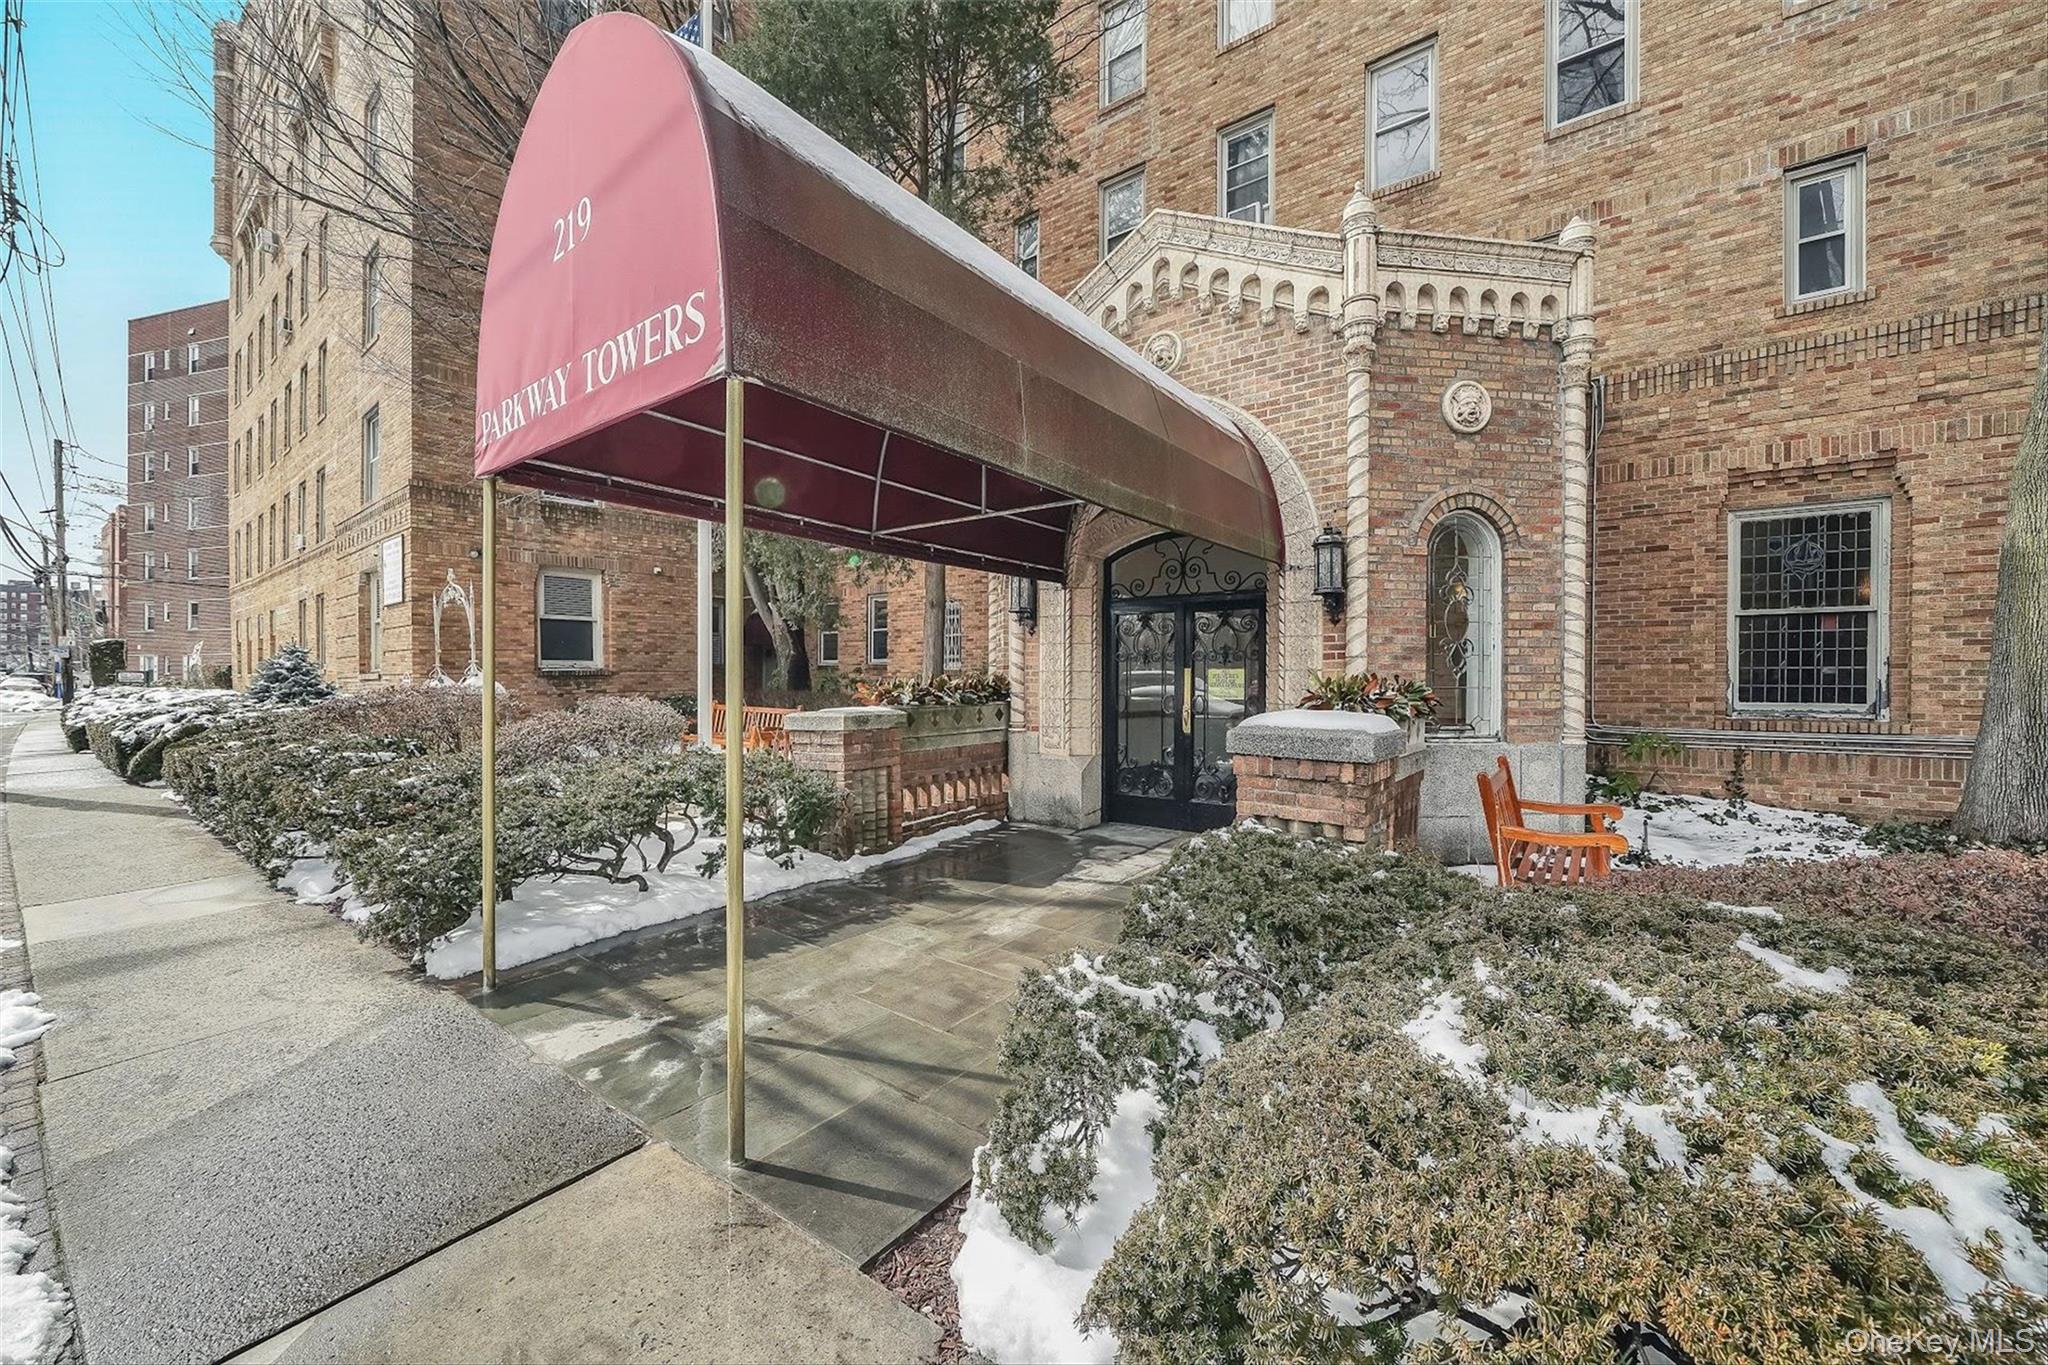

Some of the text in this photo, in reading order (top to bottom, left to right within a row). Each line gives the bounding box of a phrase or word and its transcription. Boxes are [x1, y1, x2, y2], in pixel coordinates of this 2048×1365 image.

[553, 197, 592, 262] 219
[480, 289, 706, 447] PARKWAY TOWERS
